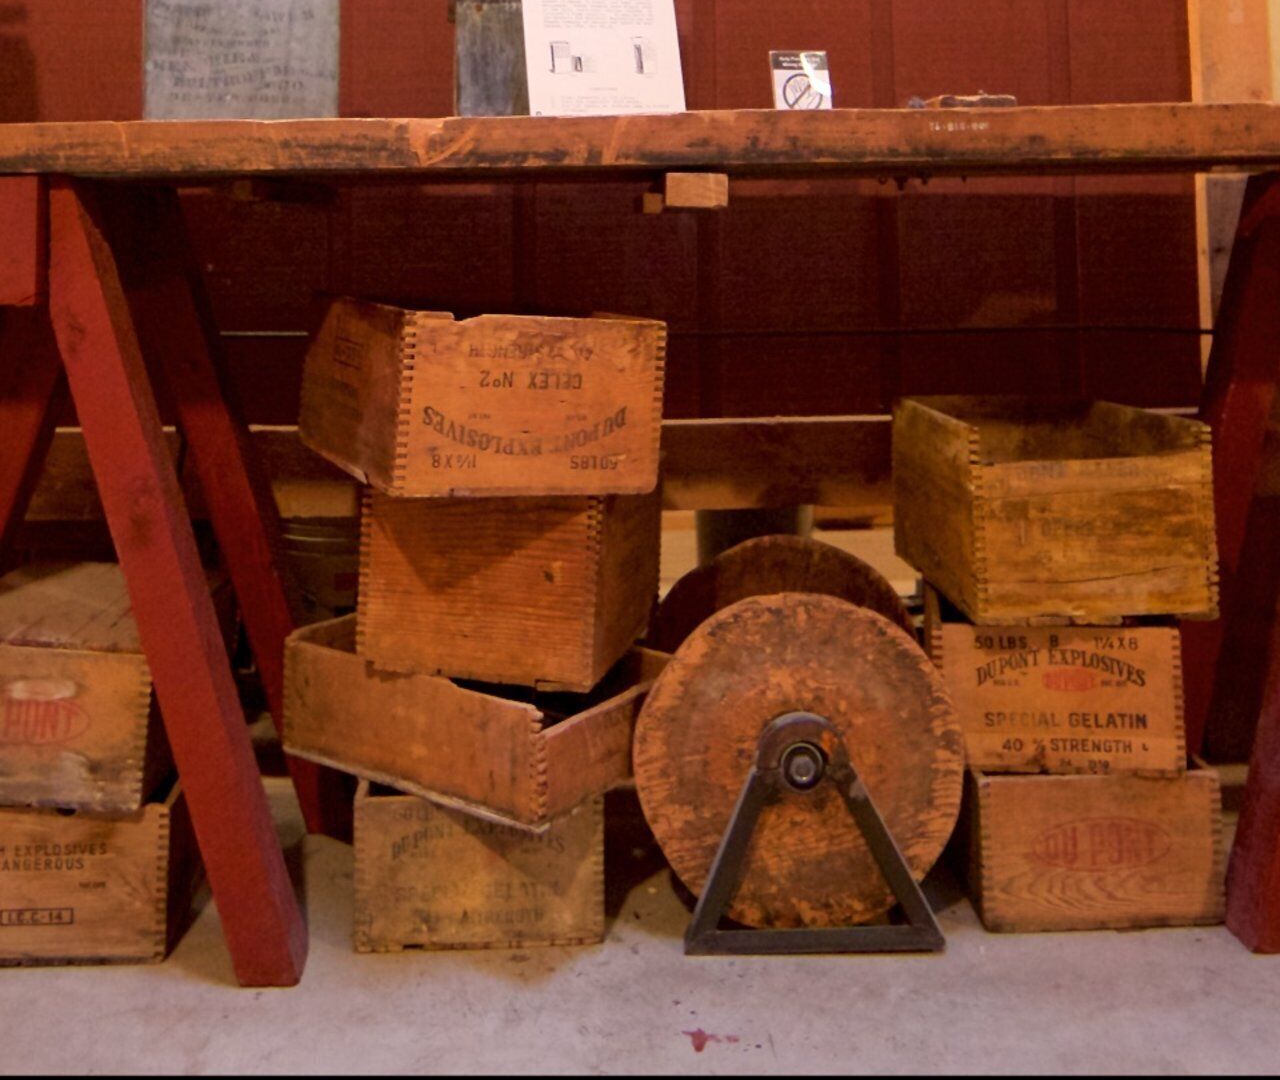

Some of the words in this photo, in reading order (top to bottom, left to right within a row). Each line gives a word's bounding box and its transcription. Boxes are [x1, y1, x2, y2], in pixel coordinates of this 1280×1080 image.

[422, 405, 543, 456] EXPLOSIVES
[974, 635, 994, 650] 50
[999, 636, 1028, 650] LBS
[1048, 648, 1146, 688] EXPLOSIVES
[984, 711, 1060, 727] SPECIAL
[1068, 712, 1148, 730] GELATIN
[1001, 737, 1024, 752] 40
[1050, 738, 1133, 753] STRENGTH
[14, 842, 108, 857] EXPLOSIVES
